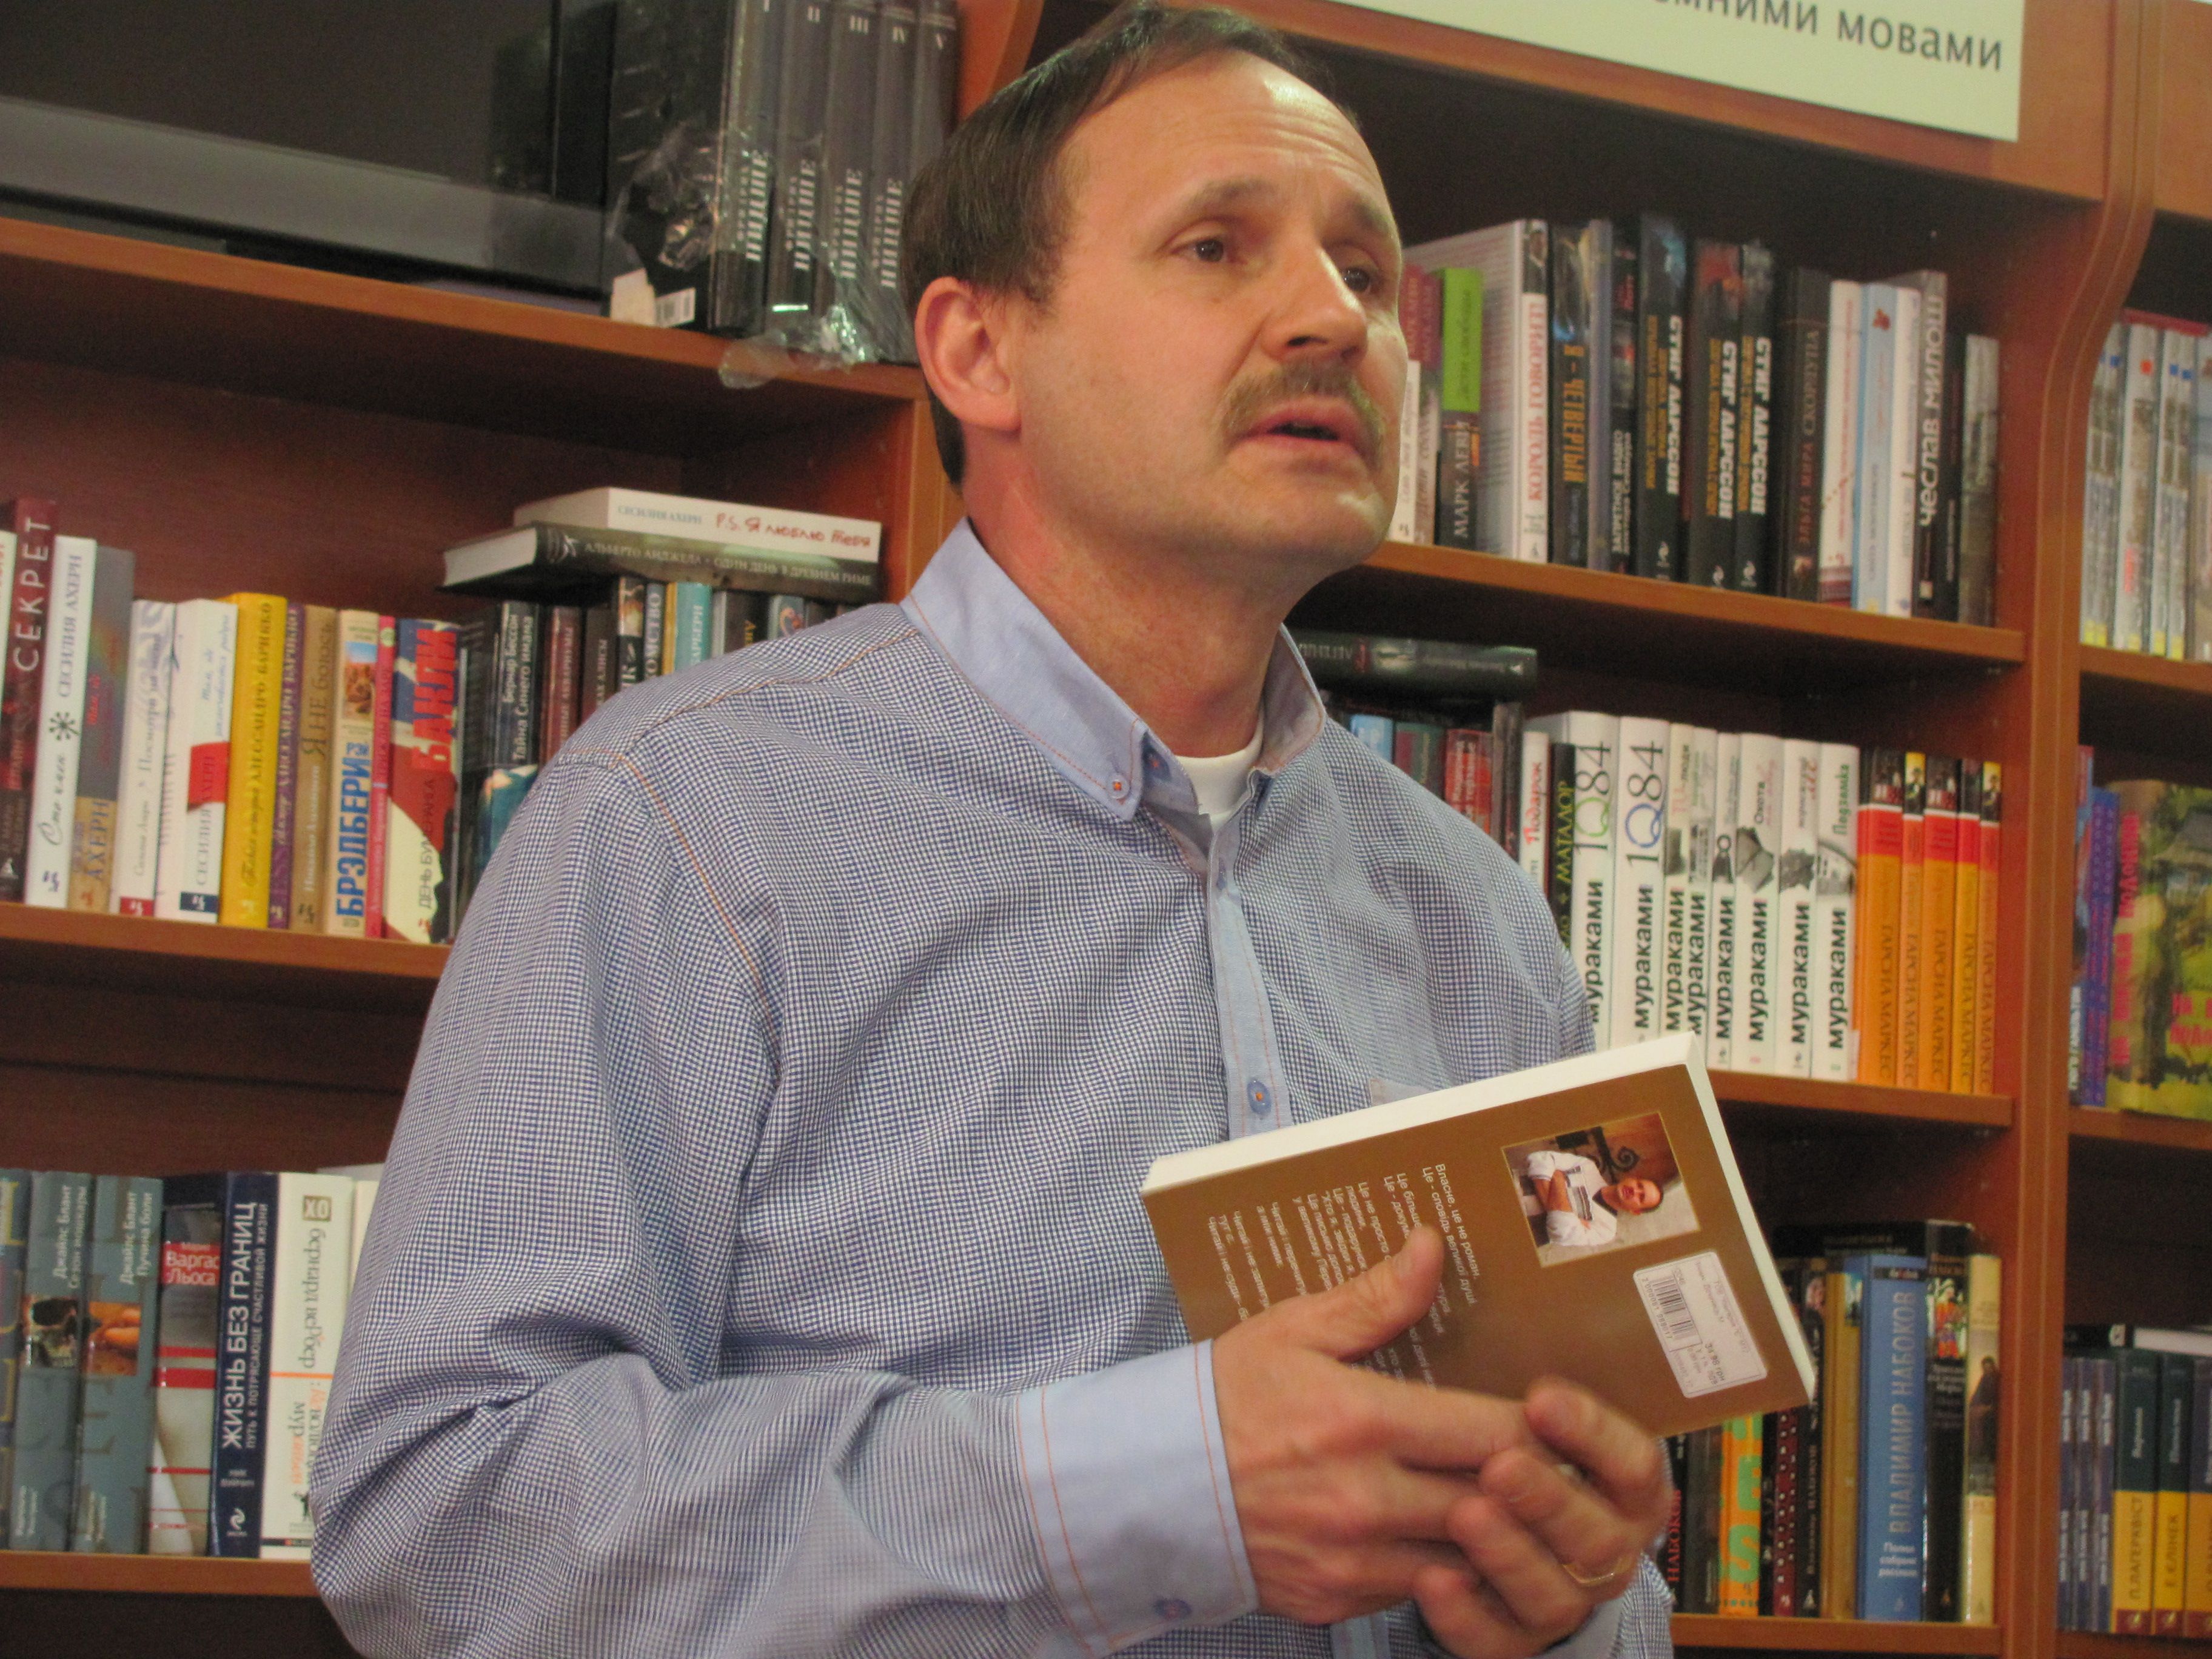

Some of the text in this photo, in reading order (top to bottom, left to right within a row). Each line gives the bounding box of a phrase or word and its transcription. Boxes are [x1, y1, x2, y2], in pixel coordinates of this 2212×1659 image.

[1837, 10, 2002, 71] мовами
[1527, 416, 1545, 502] КОРОЛЬ
[1719, 340, 1737, 520] СТИГ ЛАРССОН
[1751, 337, 1771, 515] СТИГ ЛАРССОН
[1919, 418, 1940, 526] чеслав
[1454, 480, 1469, 538] МАРК
[12, 517, 51, 672] СЕКРЕТ
[57, 555, 82, 698] СЕСИЛИЯ АХЕРН
[298, 737, 328, 760] Я
[309, 700, 326, 731] НЕ
[412, 628, 455, 769] БАКЛИ
[86, 802, 109, 882] АХЕРН
[195, 807, 214, 886] СЕСИЛИЯ
[334, 757, 372, 917] БРЭДБЕРИ
[1554, 780, 1574, 883] МАТАДОР
[1575, 740, 1612, 855] 1Q84
[1624, 739, 1664, 869] 1Q84
[1832, 764, 1851, 835] Подземка
[418, 868, 434, 910] ДЕНЬ
[1584, 881, 1605, 1025] мураками
[1634, 886, 1654, 1029] мураками
[1664, 889, 1684, 1031] мураками
[1686, 894, 1705, 1036] мураками
[1715, 899, 1734, 1039] мураками
[1748, 901, 1768, 1042] мураками
[1790, 903, 1810, 1044] мураками
[1828, 910, 1847, 1049] мураками
[257, 1203, 269, 1245] ЖИЗНИ
[1305, 1192, 1319, 1210] Це
[1332, 1187, 1345, 1205] Це
[1357, 1181, 1389, 1253] Це не просто
[1382, 1175, 1396, 1193] Це
[1395, 1171, 1409, 1190] Це
[1422, 1165, 1435, 1184] Це
[1430, 1190, 1452, 1233] сповідь
[1446, 1233, 1467, 1277] великої
[1435, 1162, 1481, 1280] Власне, це не роман.
[252, 1248, 266, 1322] СЧАСТЛИВОЙ
[1220, 1257, 1231, 1273] не
[1244, 1252, 1255, 1267] не
[221, 1202, 257, 1449] ЖИЗНЬ БЕЗ ГРАНИЦ
[1888, 1292, 1914, 1396] НАБОКОВ
[246, 1420, 257, 1449] ПУТЬ
[1888, 1403, 1913, 1533] ВЛАДИМИР
